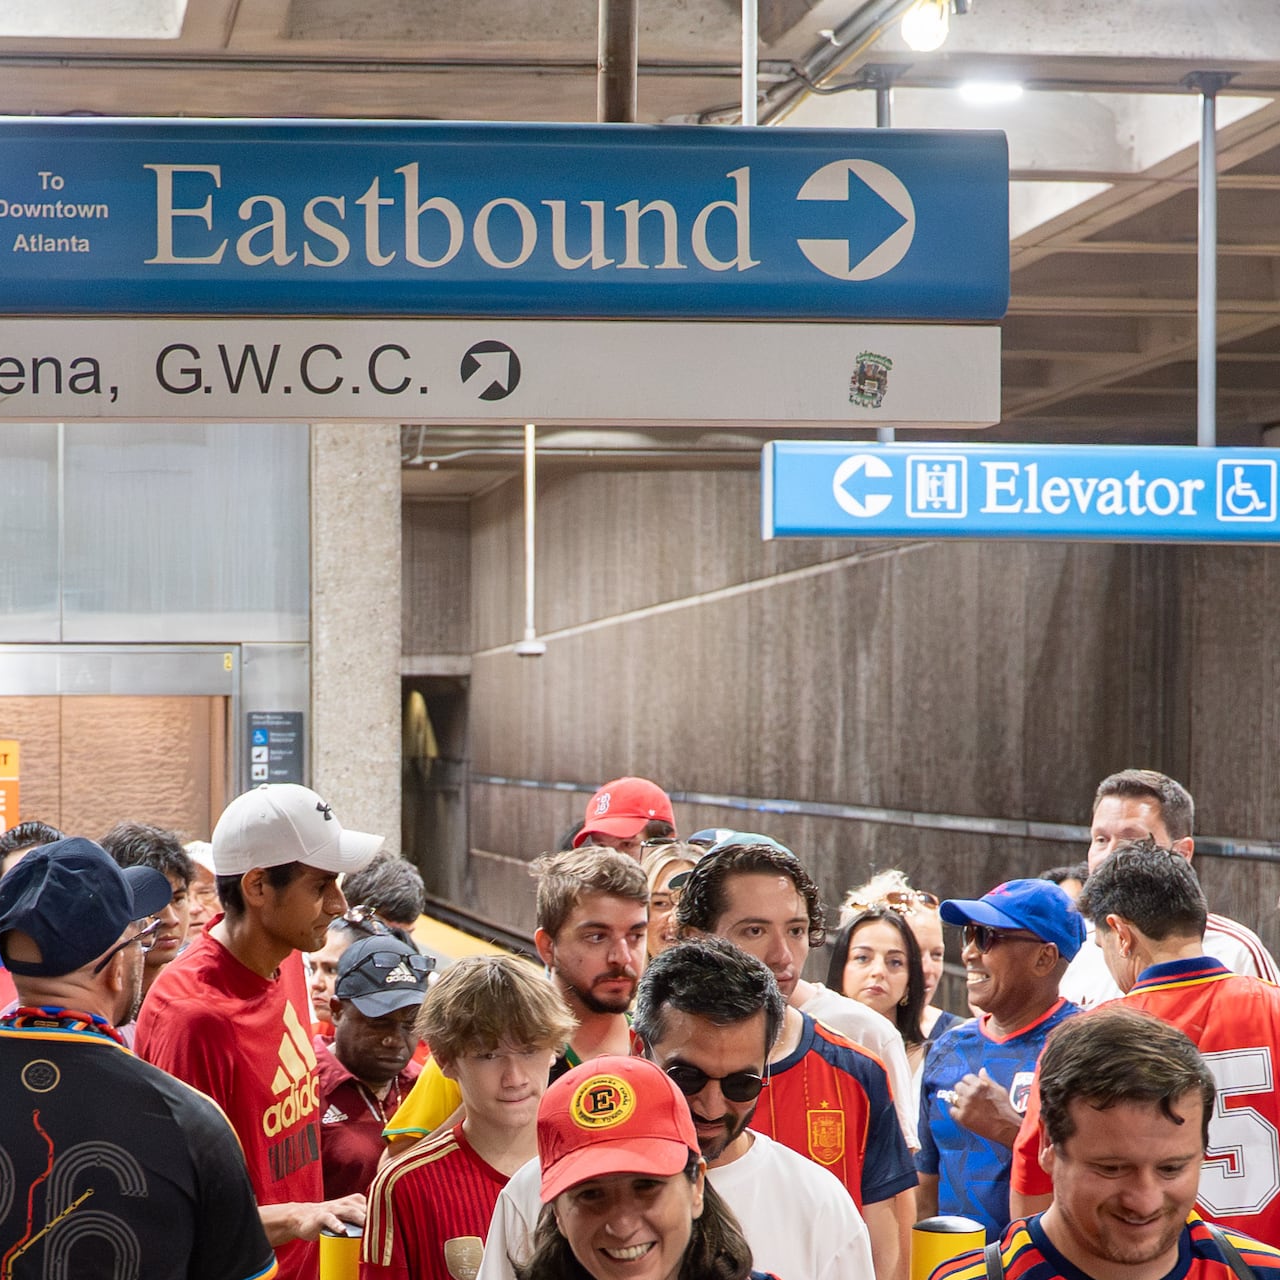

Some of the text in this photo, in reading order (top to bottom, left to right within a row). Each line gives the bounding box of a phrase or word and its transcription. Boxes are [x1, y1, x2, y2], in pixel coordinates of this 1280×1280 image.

[38, 171, 65, 190] To
[144, 161, 761, 271] Eastbound
[13, 233, 90, 252] Atlanta
[156, 343, 429, 396] G.W.C.C.
[980, 460, 1204, 517] Elevator
[385, 974, 417, 984] adidas
[322, 1113, 349, 1125] adidas
